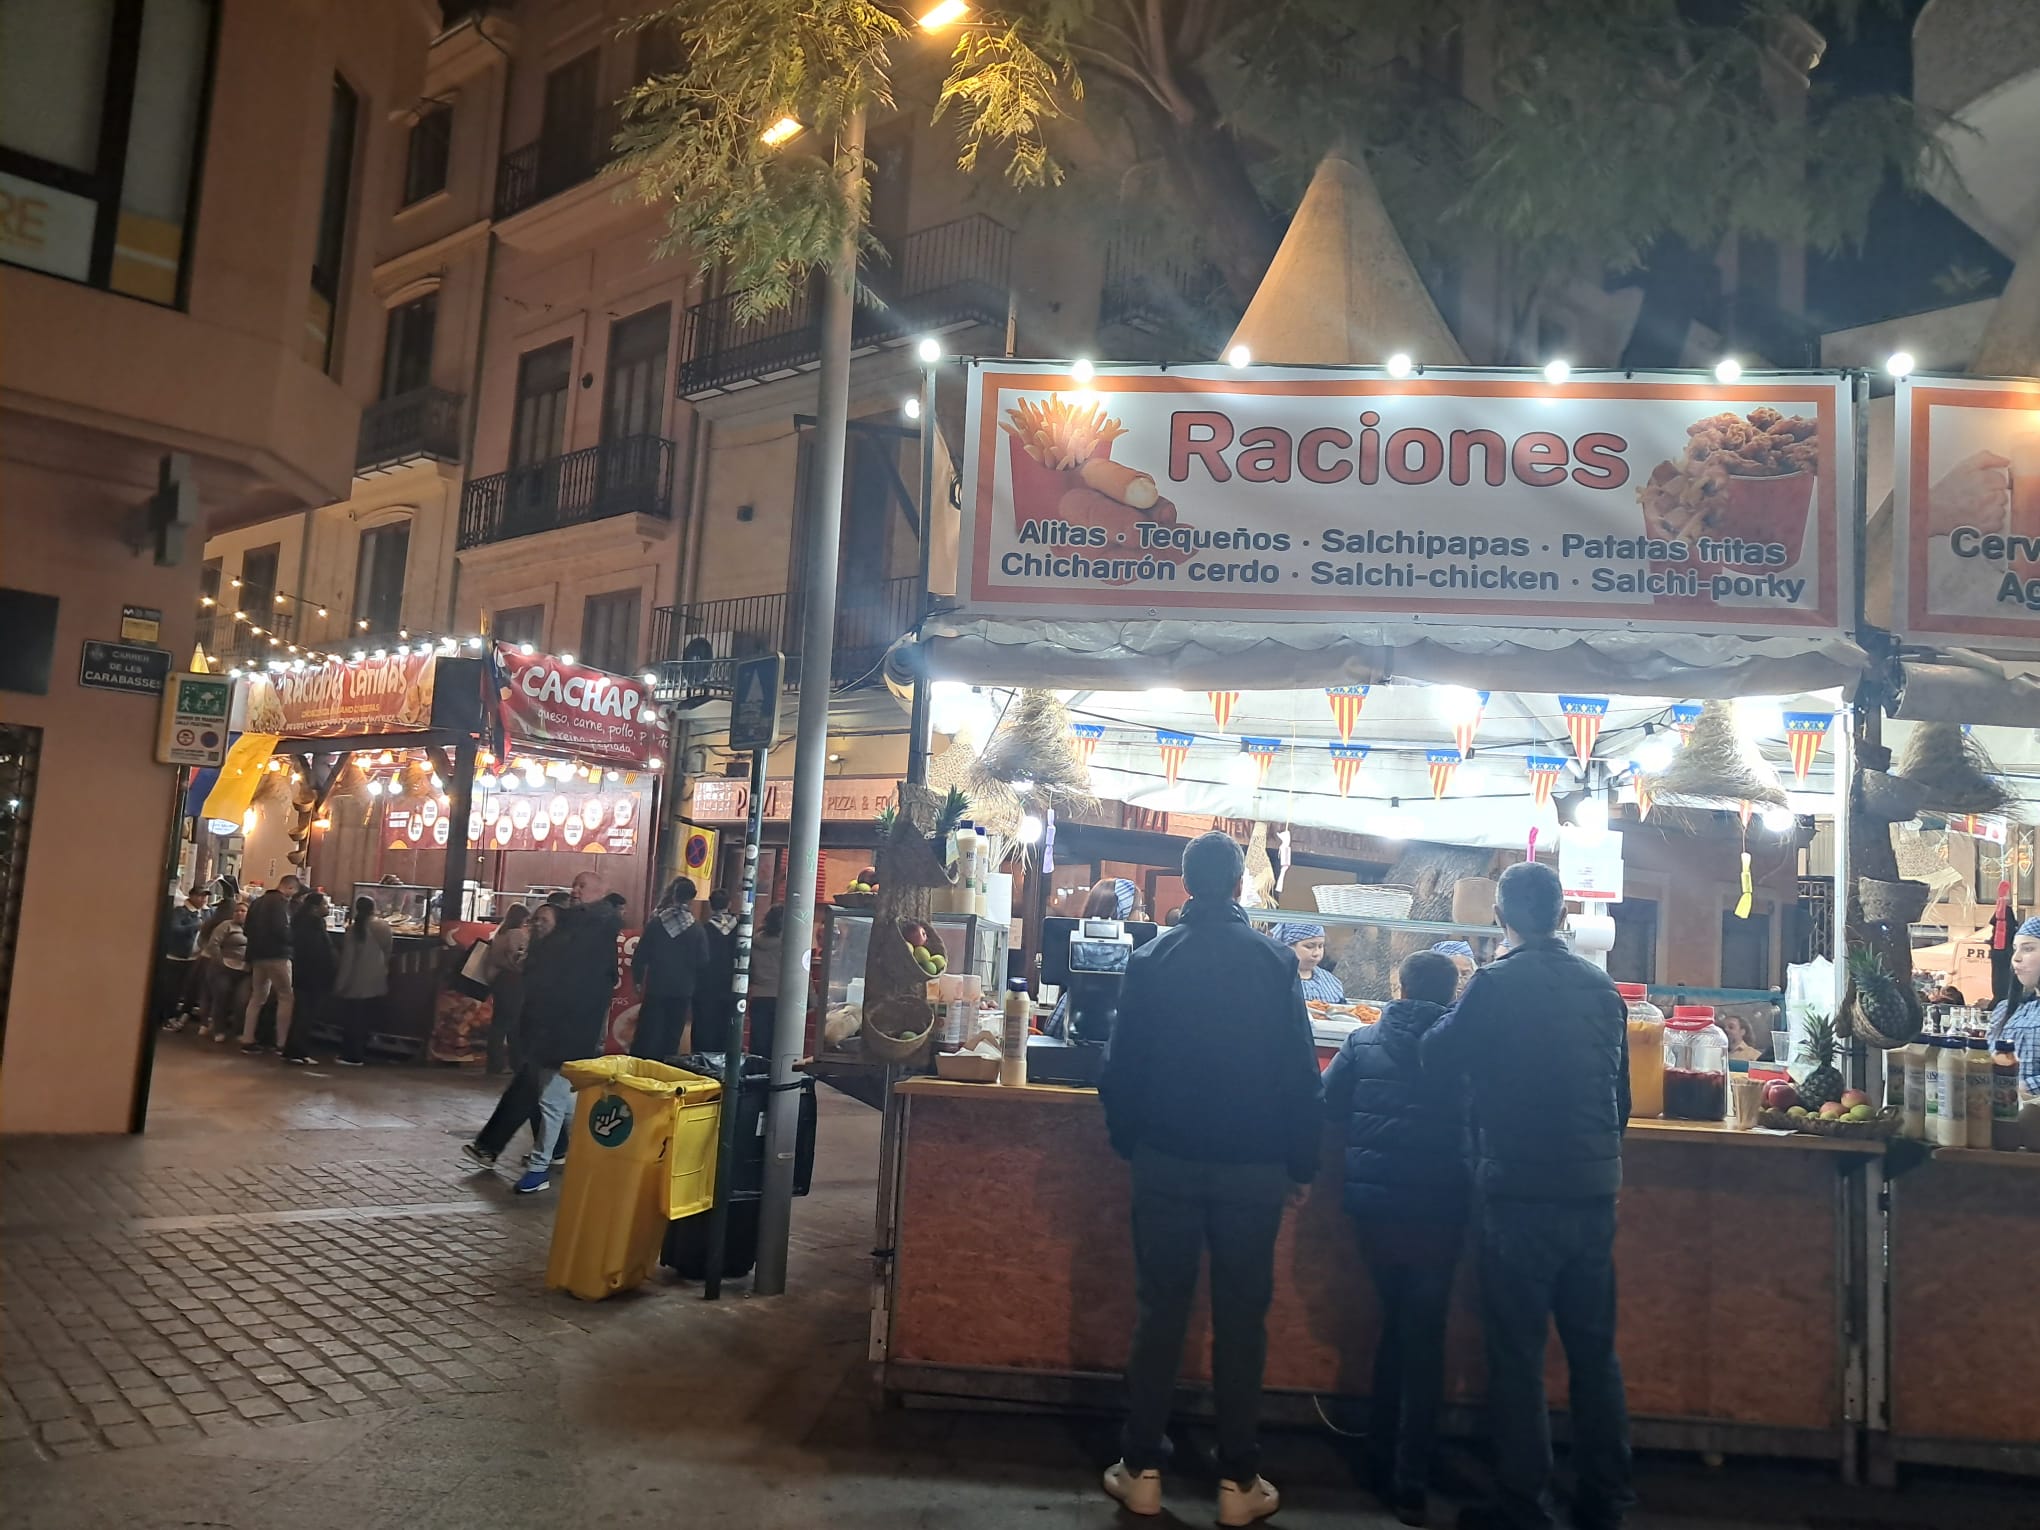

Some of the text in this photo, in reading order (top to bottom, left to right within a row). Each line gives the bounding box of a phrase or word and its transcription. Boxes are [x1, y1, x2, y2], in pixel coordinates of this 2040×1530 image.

[1168, 410, 1630, 490] Raciones
[1019, 519, 1785, 564] Alitas Tequeños Salchipapas Patatas fritas
[1951, 526, 2040, 562] Cerv
[1001, 552, 1805, 604] Chicharrón cerdo Salchi-chicken Salchi-porky
[109, 662, 142, 675] DE LES
[112, 650, 150, 663] CARRER
[350, 664, 407, 699] LATINAS
[538, 708, 570, 727] queso,
[573, 716, 605, 734] carne,
[608, 721, 636, 741] pollo,
[827, 796, 856, 811] PIZZA
[862, 795, 869, 811] &
